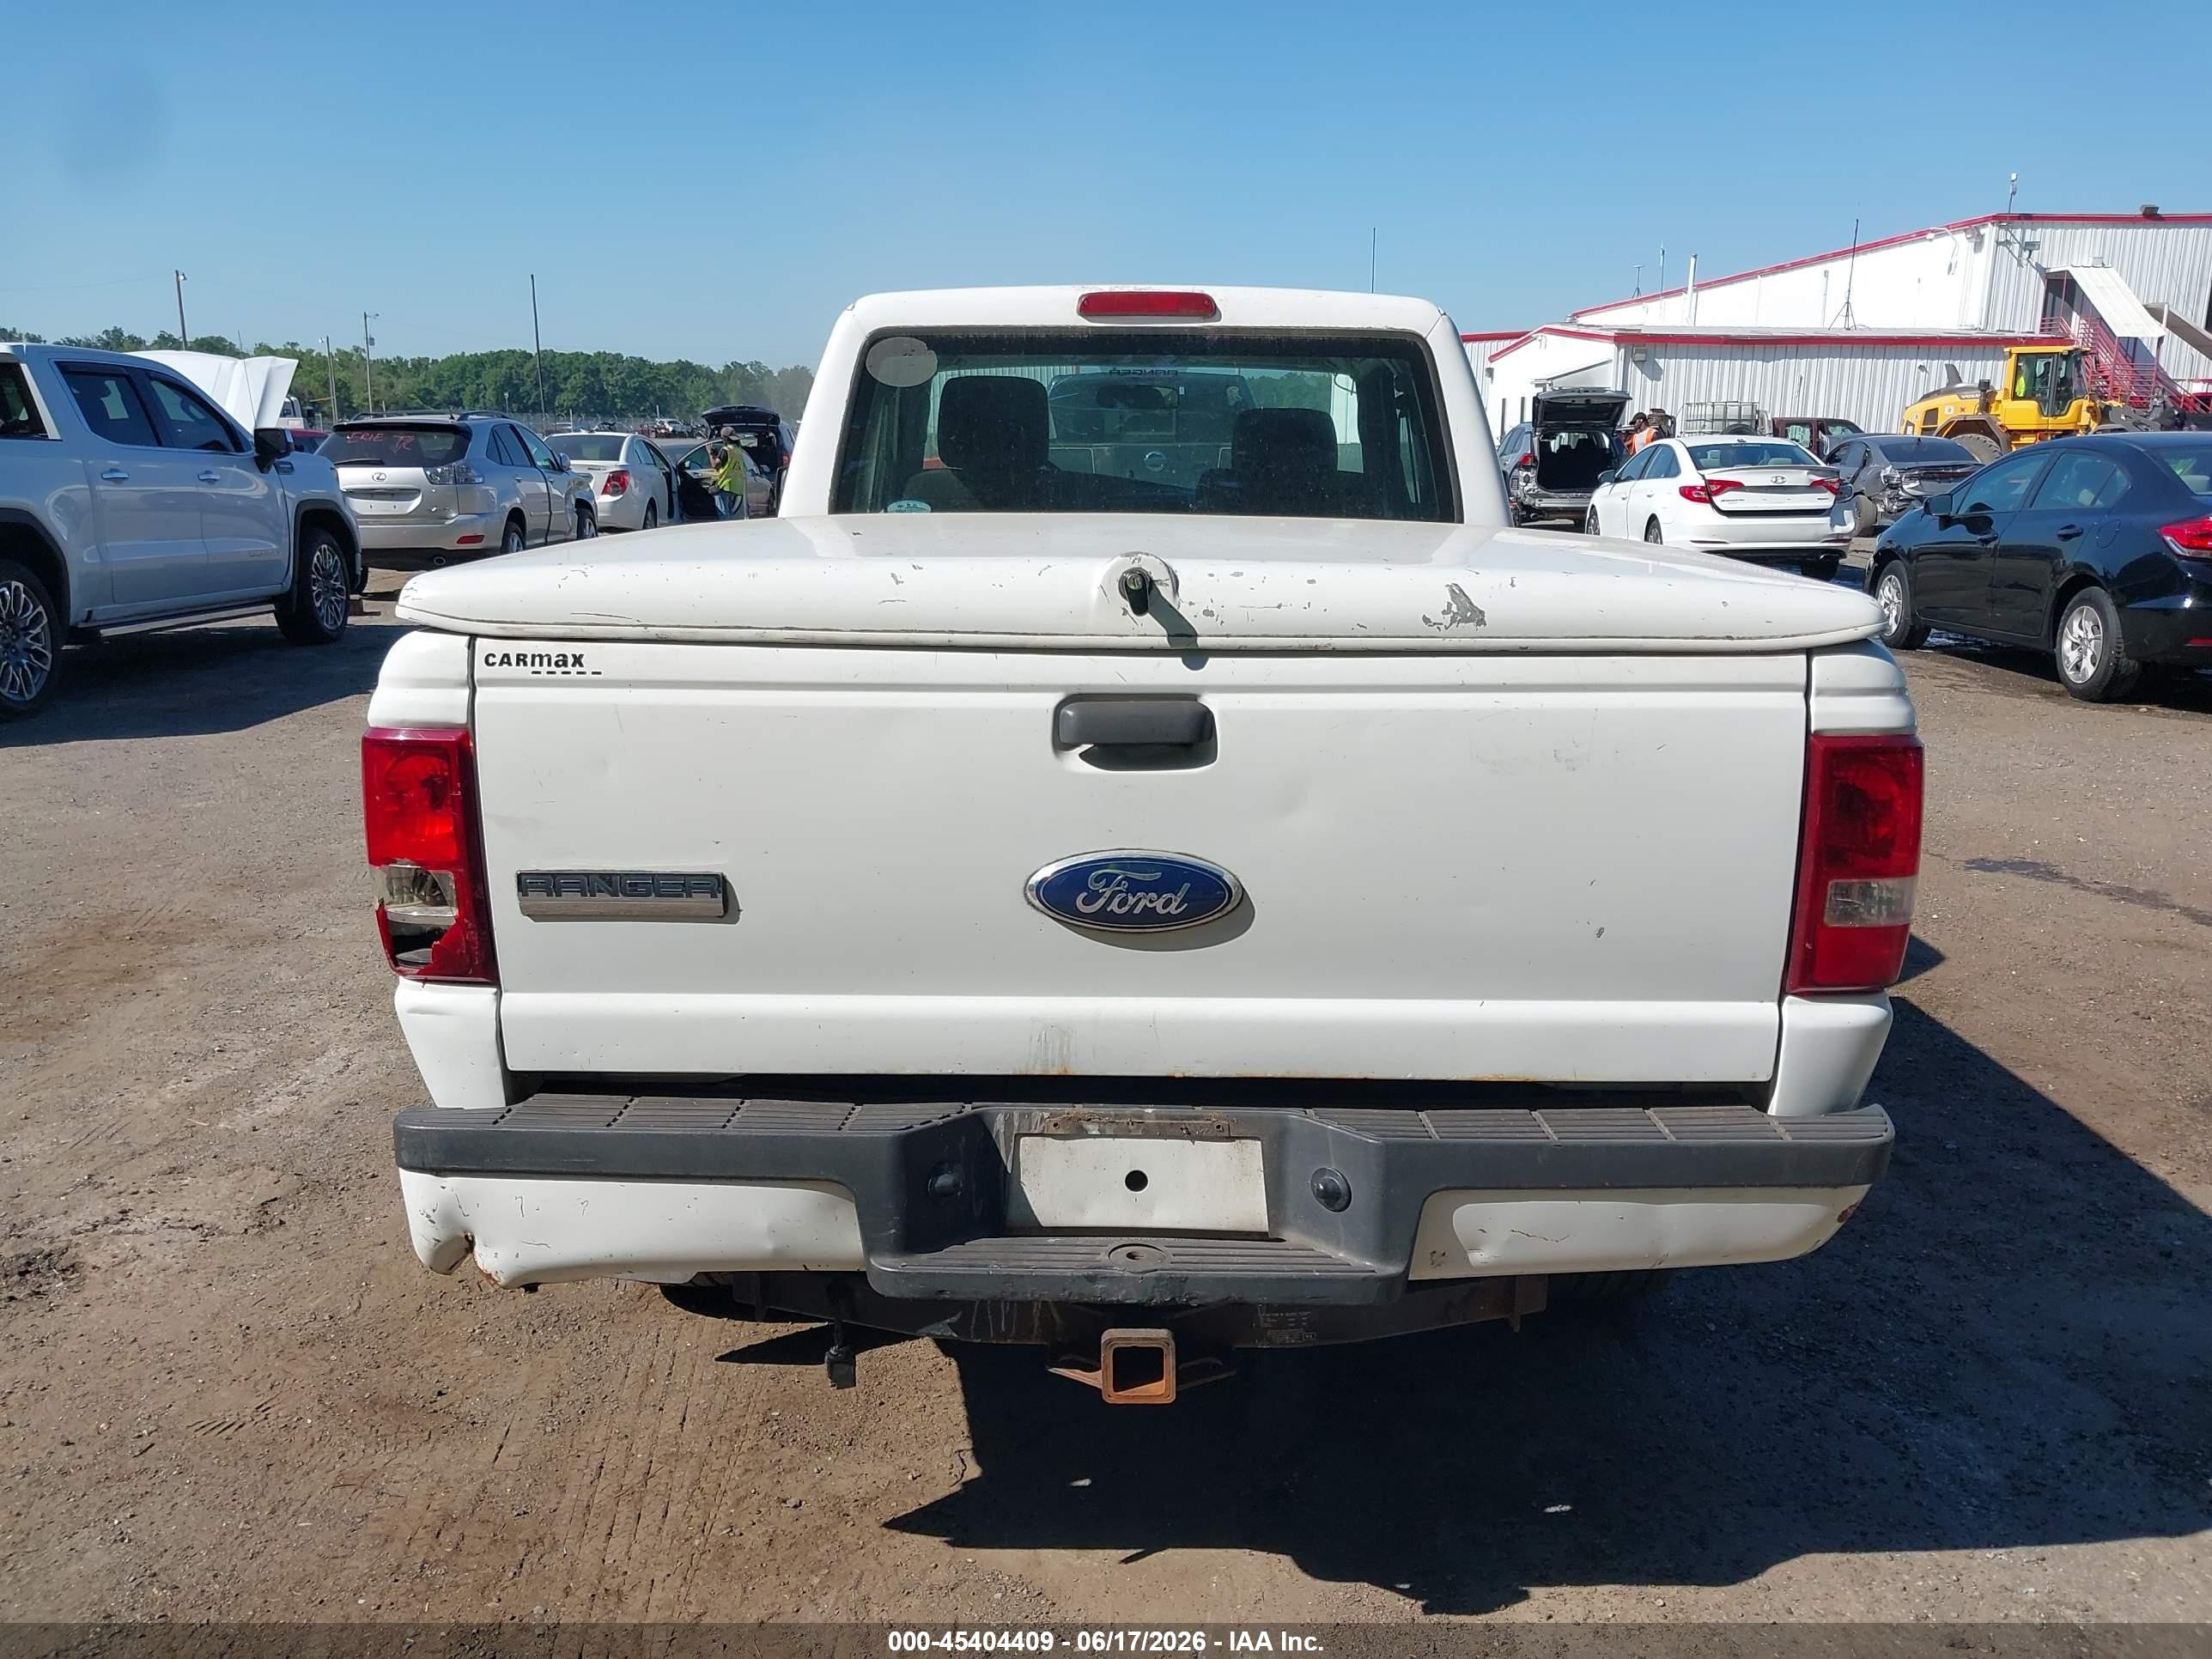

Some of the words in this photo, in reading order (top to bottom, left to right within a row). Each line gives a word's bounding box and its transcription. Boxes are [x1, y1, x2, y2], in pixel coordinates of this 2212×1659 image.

[347, 432, 385, 443] ERIE
[520, 873, 720, 898] RANGER
[1075, 868, 1191, 915] Ford
